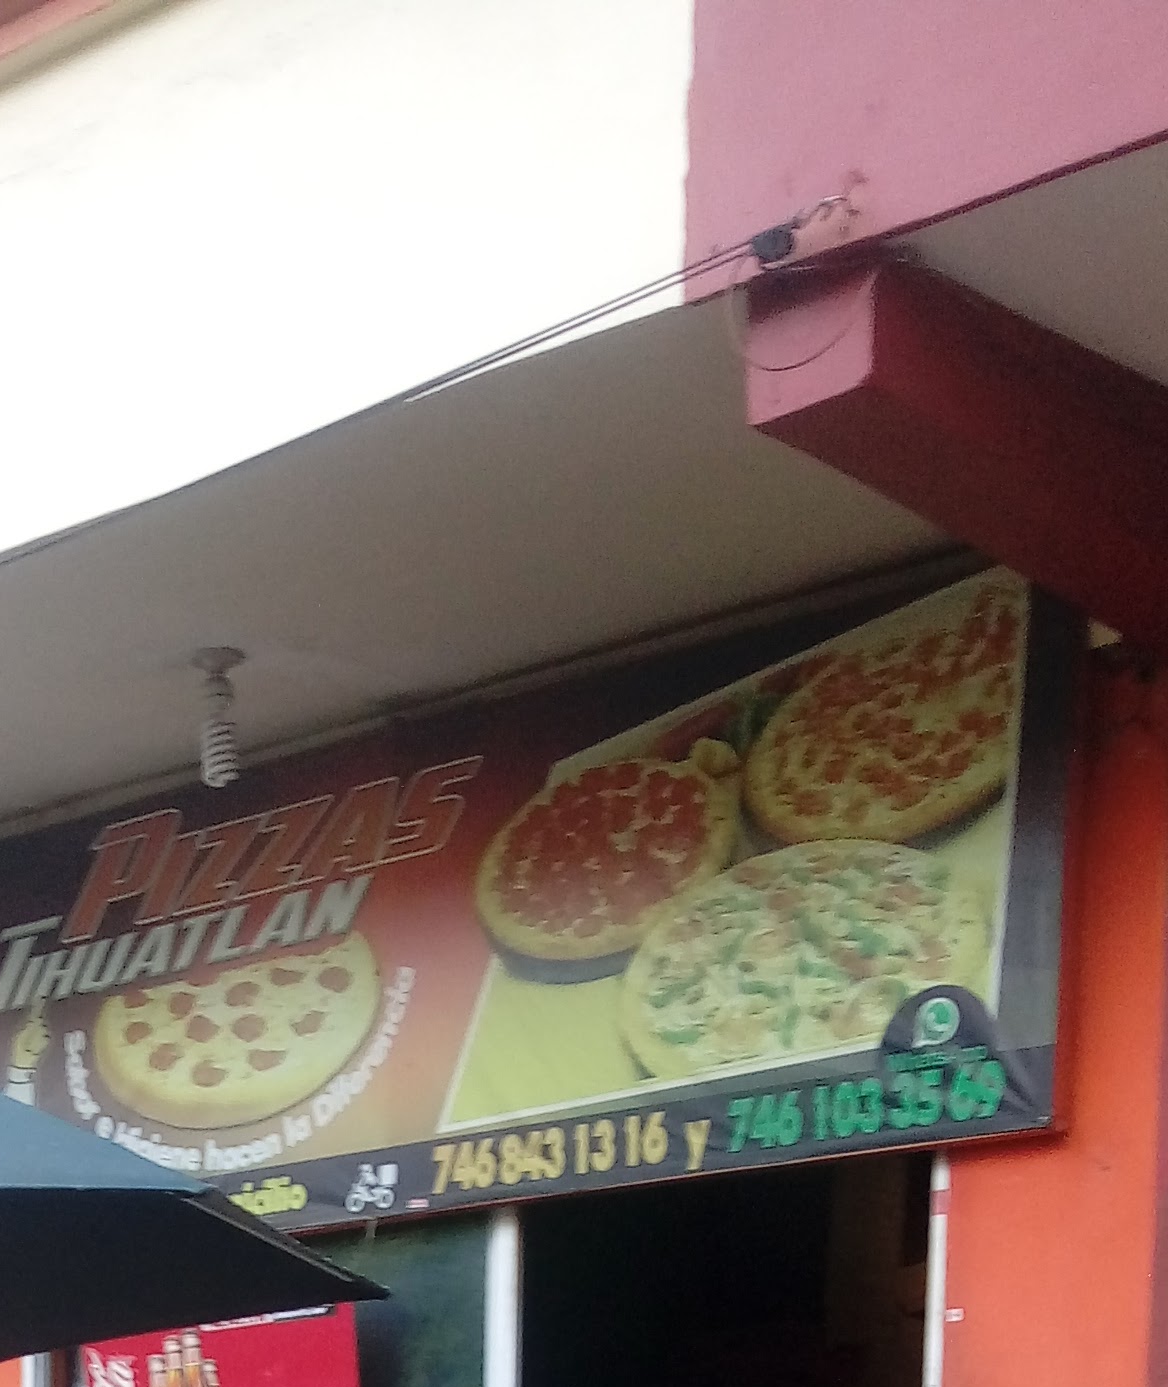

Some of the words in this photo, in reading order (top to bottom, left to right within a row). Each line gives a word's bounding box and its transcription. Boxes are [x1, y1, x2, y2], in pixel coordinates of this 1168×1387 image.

[61, 755, 483, 944] PIZZAS
[574, 1118, 616, 1176] 13
[624, 1110, 669, 1168] 16
[727, 1089, 804, 1154] 746
